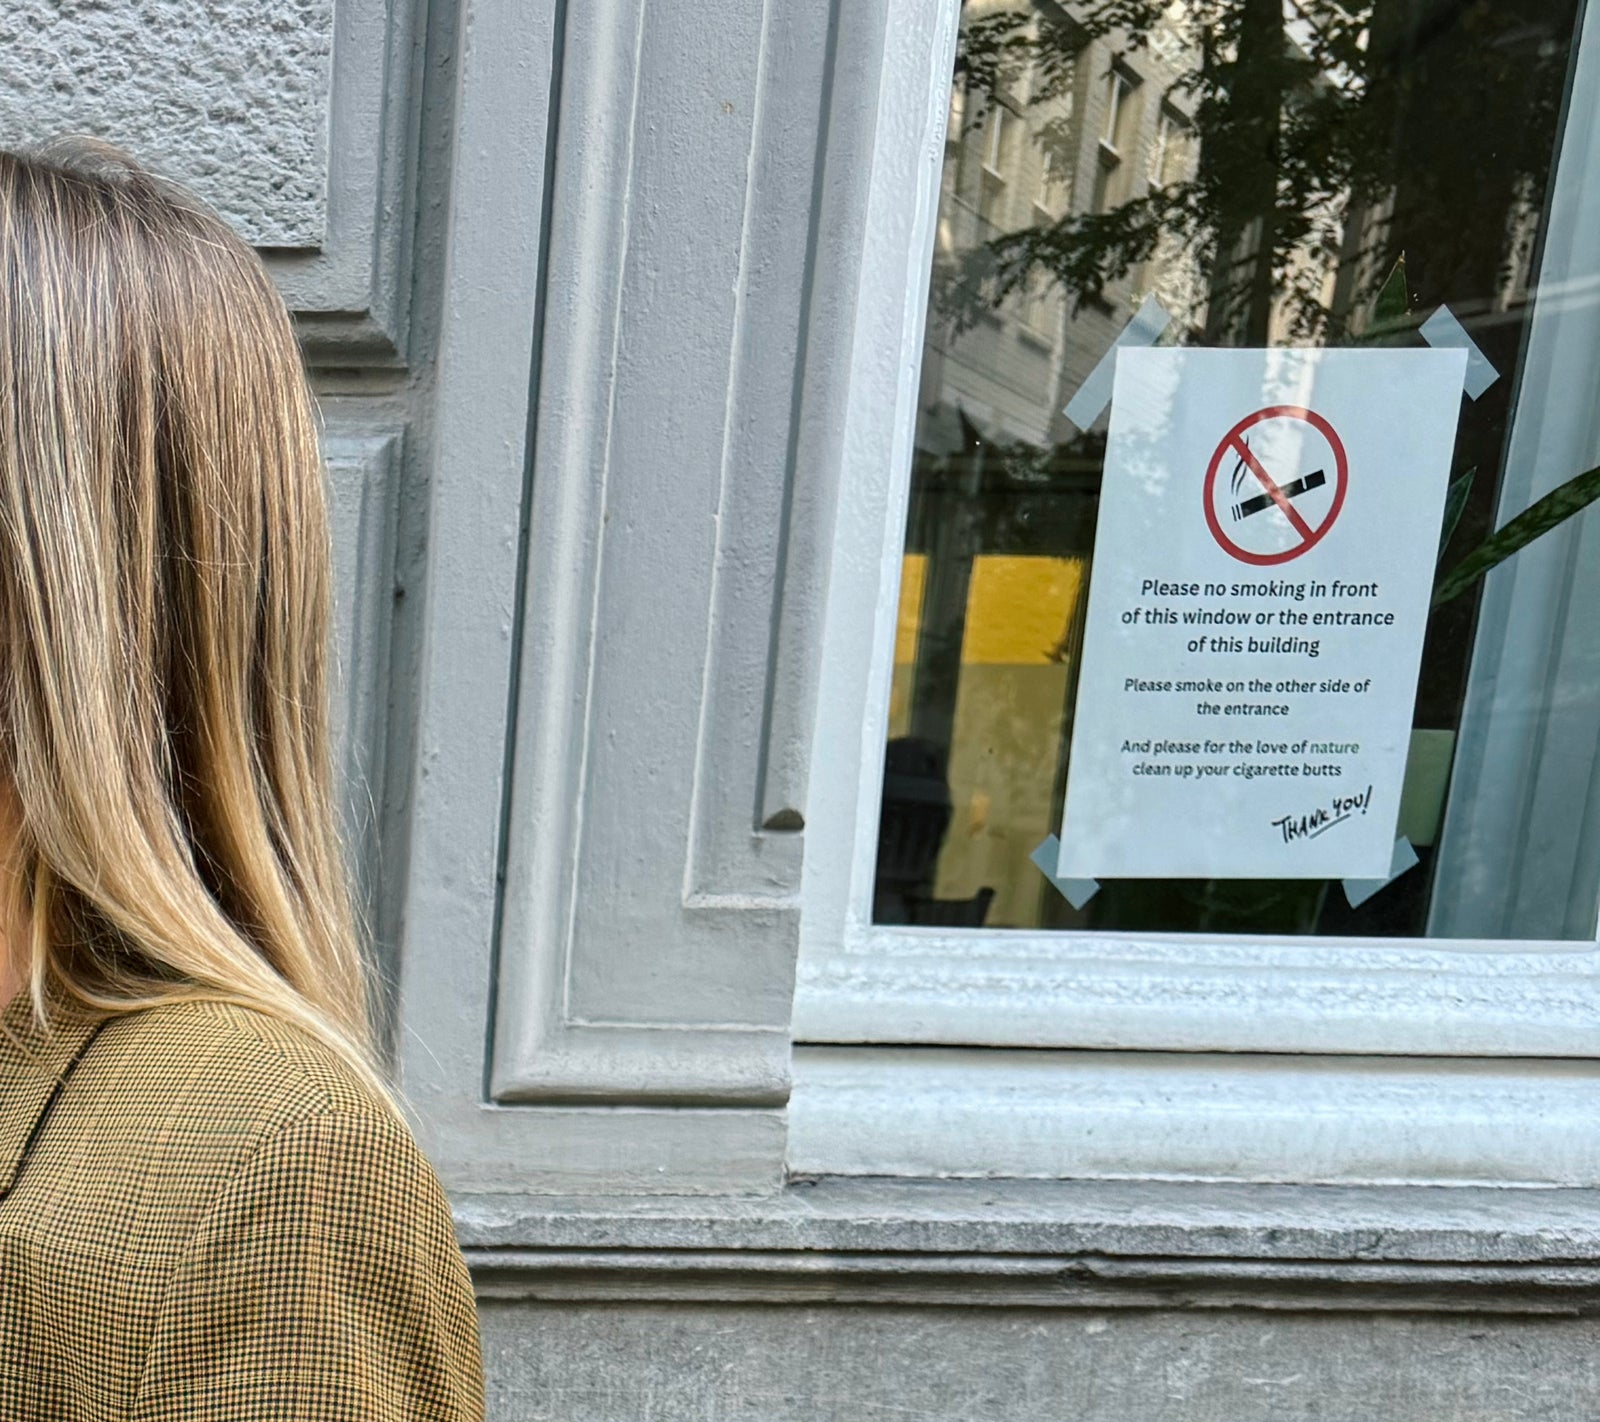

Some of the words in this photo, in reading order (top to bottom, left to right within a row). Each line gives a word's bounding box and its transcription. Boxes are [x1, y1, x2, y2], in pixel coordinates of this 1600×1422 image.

[1141, 579, 1200, 596] Please
[1204, 584, 1226, 597] no
[1230, 580, 1306, 601] smoking
[1310, 580, 1326, 597] in
[1331, 579, 1379, 597] front
[1121, 607, 1142, 625] of
[1144, 608, 1178, 625] this
[1183, 608, 1252, 626] window
[1255, 613, 1276, 626] or
[1279, 608, 1308, 626] the
[1312, 611, 1395, 626] entrance
[1187, 636, 1208, 653] of
[1210, 636, 1244, 653] this
[1248, 636, 1320, 659] building
[1124, 678, 1172, 692] Please
[1175, 678, 1223, 693] smoke
[1226, 682, 1245, 693] on
[1248, 679, 1272, 693] the
[1275, 679, 1317, 693] other
[1319, 679, 1351, 693] side
[1353, 679, 1372, 693] of
[1196, 701, 1221, 716] the
[1224, 704, 1289, 716] entrance
[1121, 739, 1151, 754] And
[1153, 740, 1202, 757] please
[1204, 740, 1227, 754] for
[1229, 740, 1253, 754] the
[1256, 740, 1288, 754] love
[1291, 740, 1309, 754] of
[1310, 742, 1360, 754] nature
[1133, 762, 1171, 777] clean
[1173, 766, 1194, 779] up
[1196, 766, 1230, 779] your
[1233, 762, 1300, 779] cigarette
[1302, 762, 1343, 777] butts
